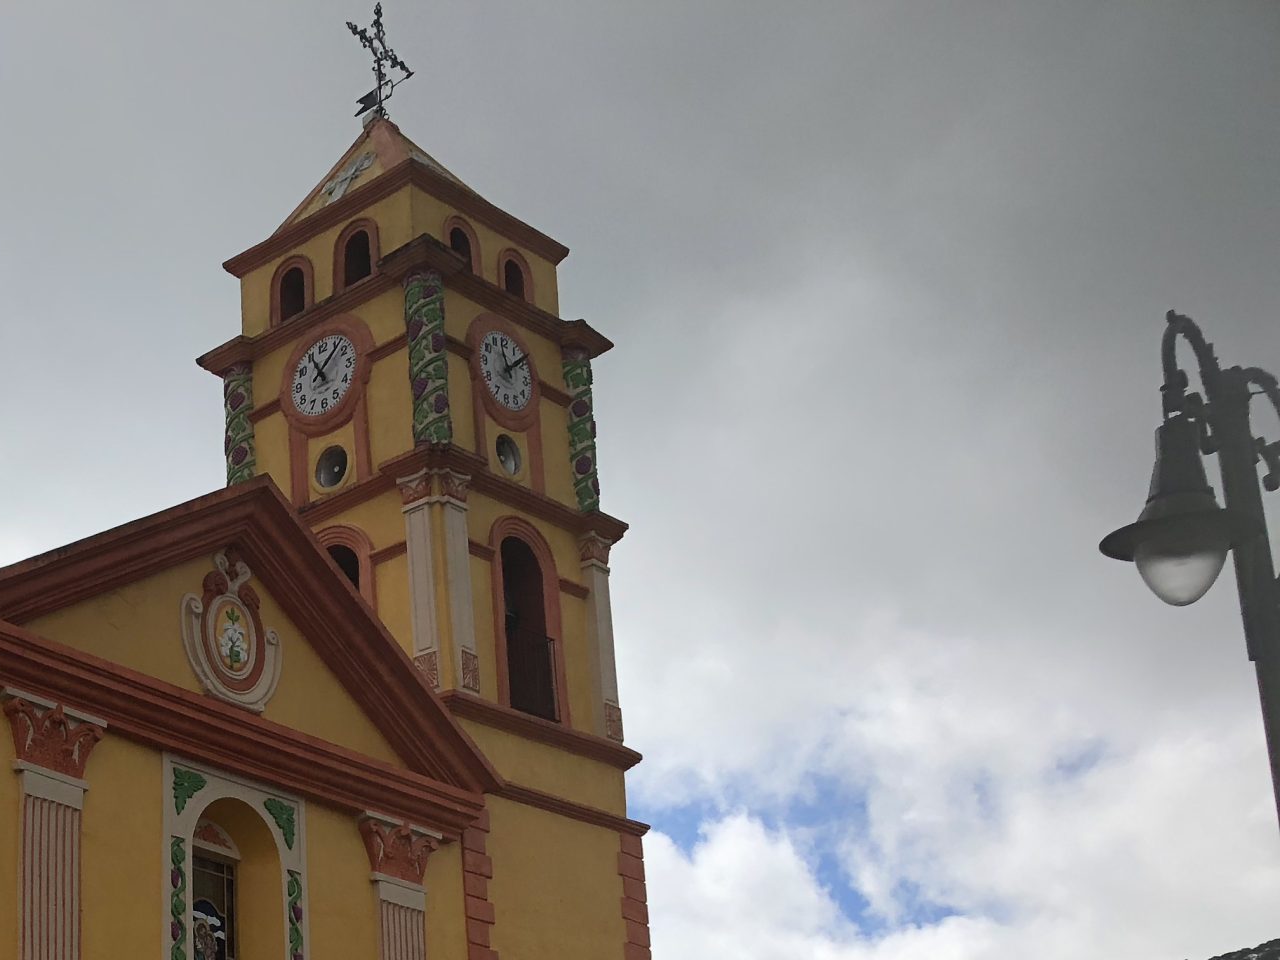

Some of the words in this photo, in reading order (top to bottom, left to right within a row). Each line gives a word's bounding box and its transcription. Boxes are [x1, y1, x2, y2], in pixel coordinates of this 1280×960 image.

[492, 336, 497, 346] 11
[501, 337, 508, 349] 12
[318, 342, 328, 354] 12
[341, 345, 347, 356] 2
[485, 343, 491, 353] 10
[308, 352, 314, 363] 11
[482, 355, 487, 365] 9
[346, 358, 352, 368] 3
[299, 366, 307, 378] 10
[486, 371, 491, 381] 8
[342, 374, 348, 383] 4
[523, 376, 528, 386] 3
[296, 383, 302, 393] 9
[495, 385, 500, 394] 7
[300, 395, 306, 404] 8
[332, 389, 339, 400] 5
[504, 394, 509, 404] 6
[520, 390, 525, 399] 4
[310, 399, 316, 410] 7
[321, 398, 328, 408] 6
[513, 395, 518, 405] 5
